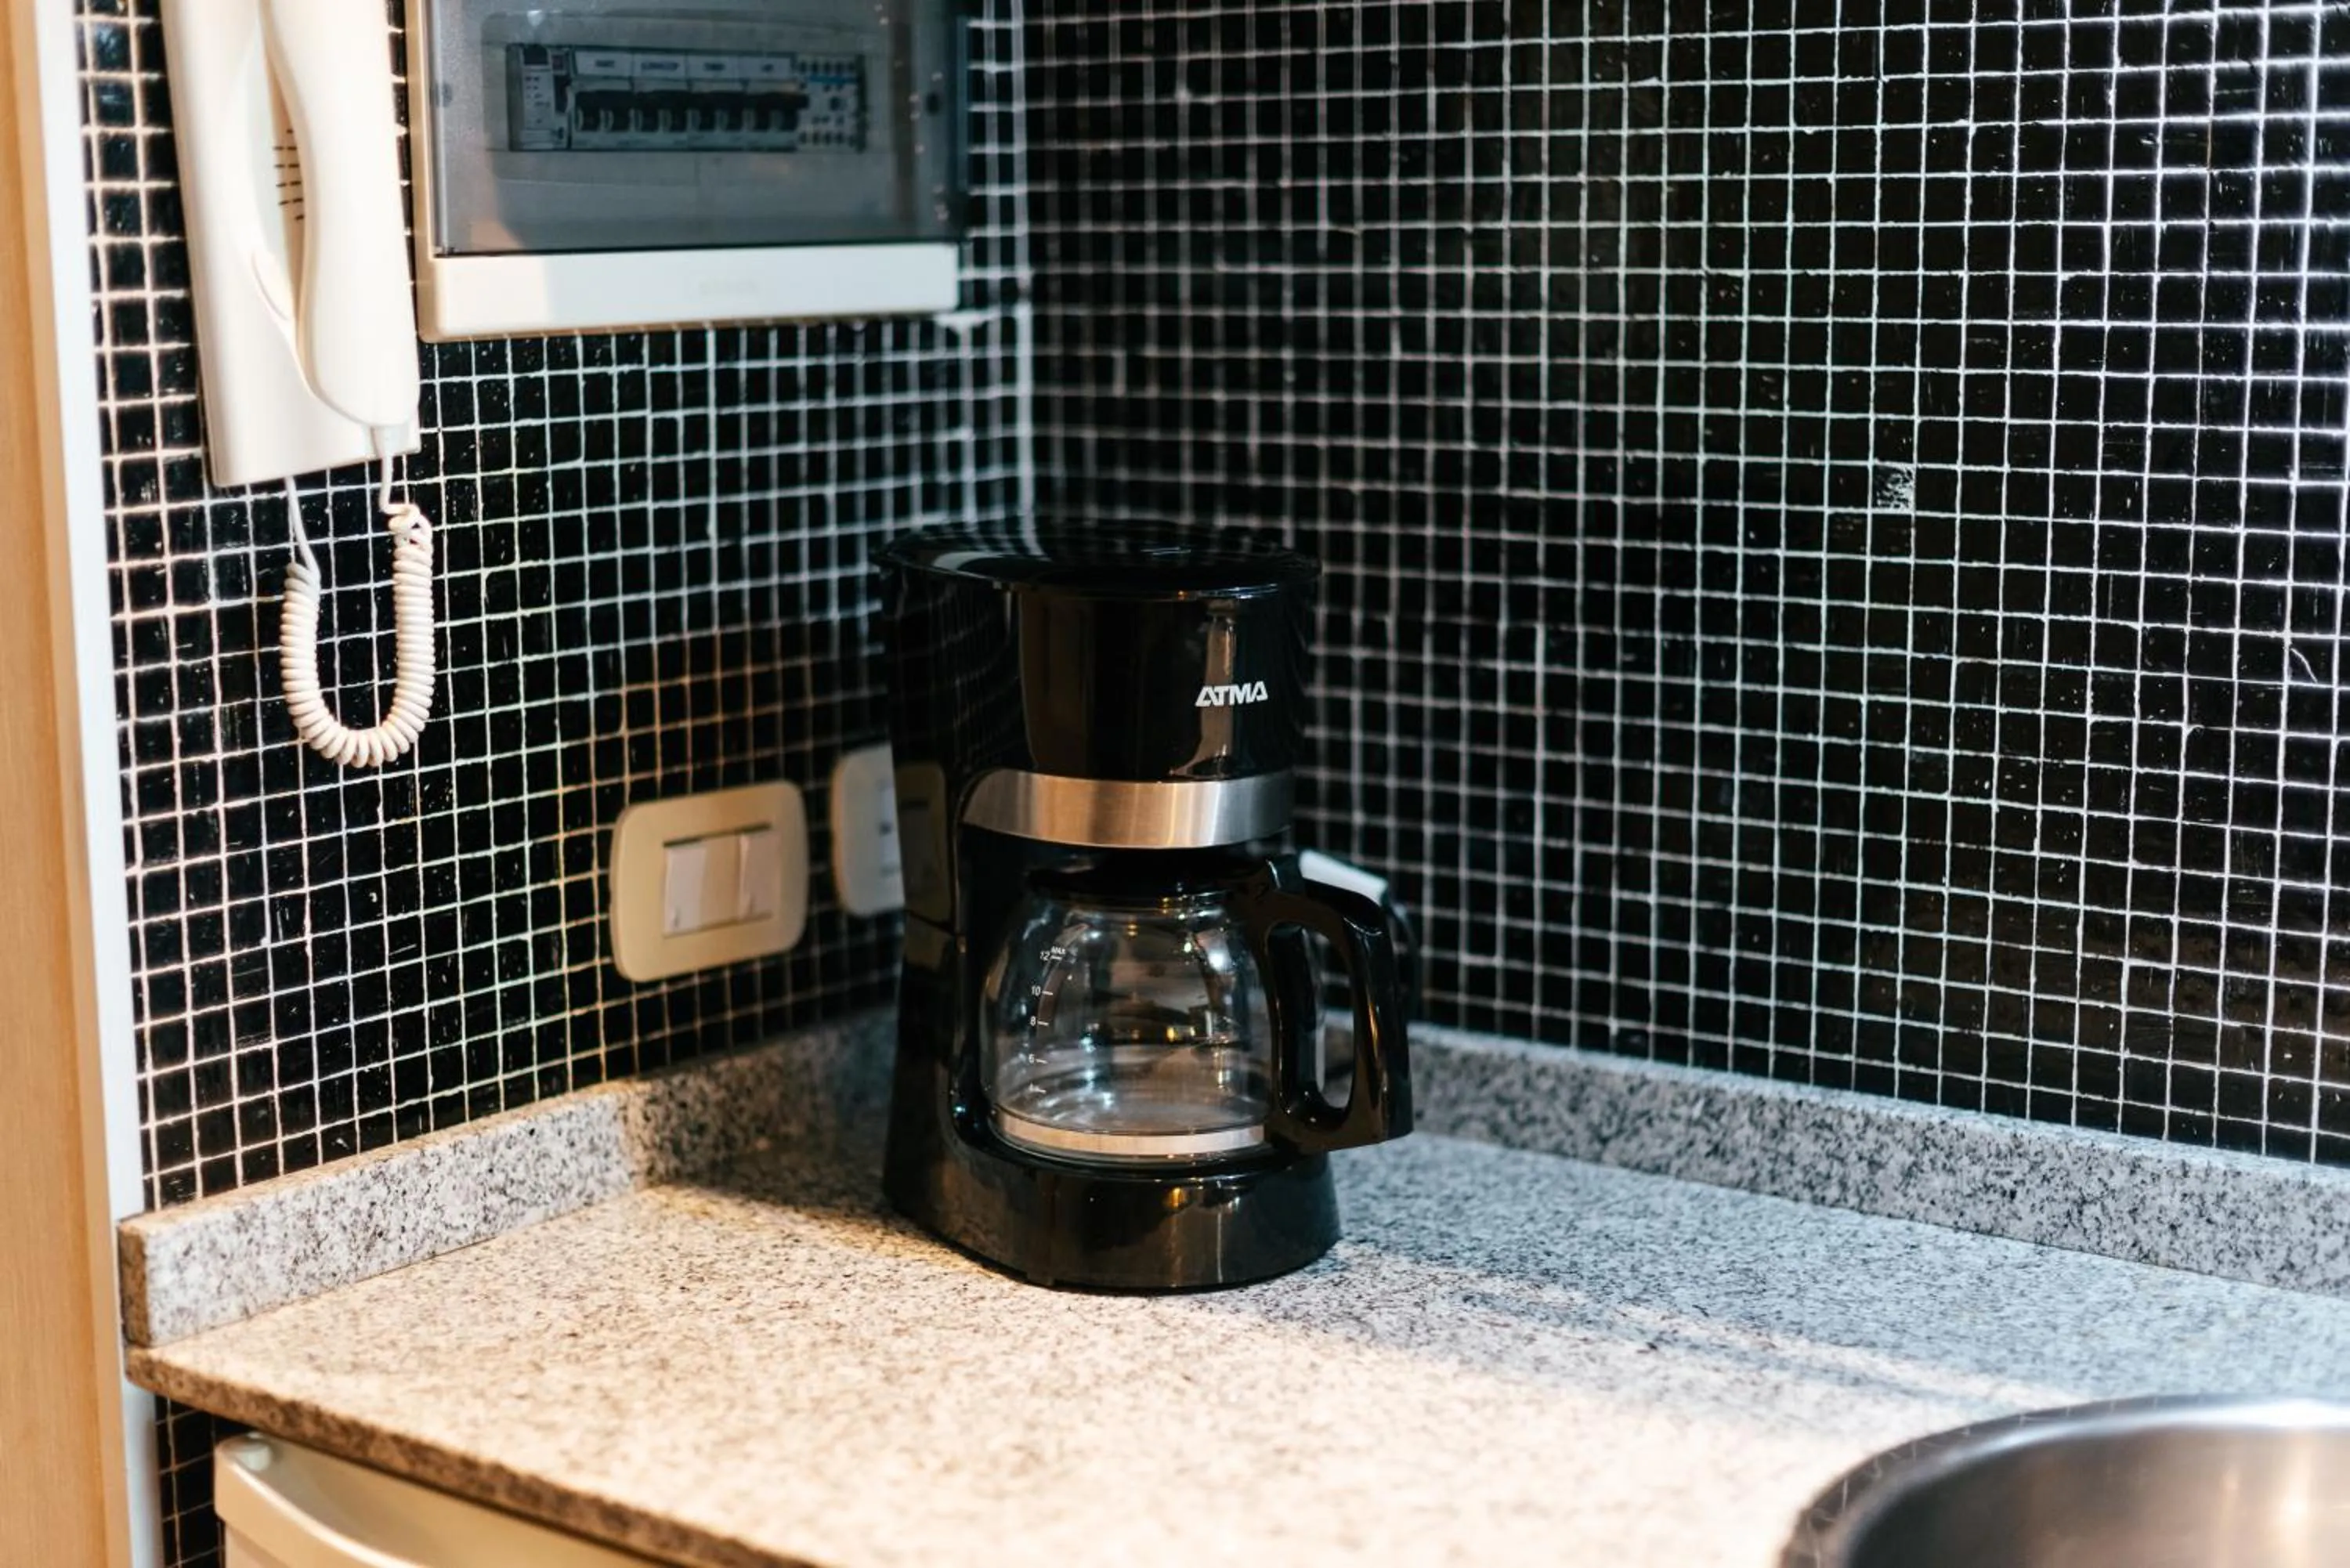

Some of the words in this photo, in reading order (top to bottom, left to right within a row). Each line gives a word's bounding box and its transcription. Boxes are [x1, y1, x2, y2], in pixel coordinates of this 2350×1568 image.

[1195, 681, 1268, 707] ATMA
[1039, 950, 1050, 961] 12
[1031, 985, 1040, 996] 10
[1030, 1016, 1036, 1026] 8
[1029, 1053, 1034, 1064] 6
